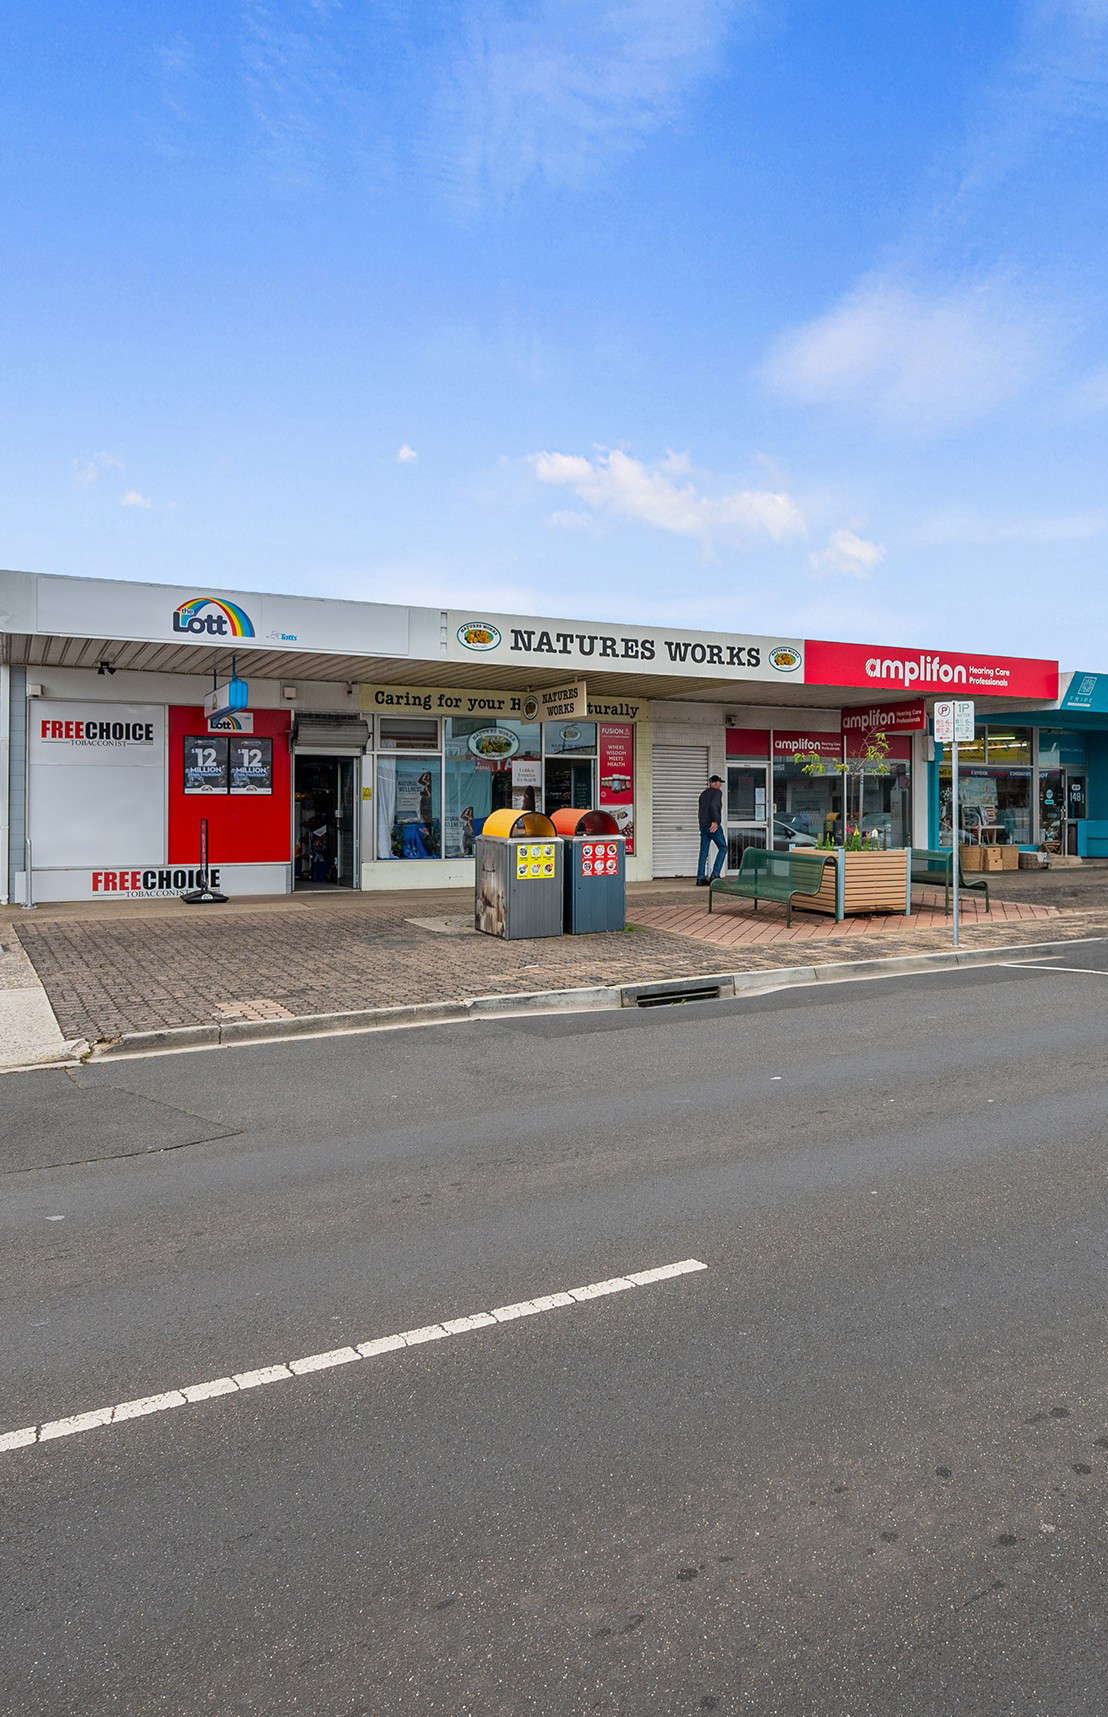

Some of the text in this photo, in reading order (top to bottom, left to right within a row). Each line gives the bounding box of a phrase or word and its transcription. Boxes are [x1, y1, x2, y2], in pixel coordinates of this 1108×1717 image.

[173, 611, 228, 636] Lott
[280, 633, 298, 641] Tatts
[510, 629, 761, 667] NATURES WORKS
[865, 655, 1011, 687] amplifon Hearing Care
[969, 677, 1009, 687] Professionals
[374, 690, 433, 710] Caring
[437, 693, 463, 708] for
[467, 698, 505, 712] your
[541, 687, 579, 705] NATURES
[1069, 695, 1094, 703] TRIBE
[546, 702, 575, 717] WORKS
[586, 703, 640, 719] turally
[210, 719, 232, 730] Lott
[842, 709, 896, 732] amplifon
[41, 720, 154, 741] FREECHOICE
[472, 729, 516, 742] NATURES WORKS
[601, 727, 624, 735] FUSION
[774, 738, 821, 752] amplifon
[1069, 792, 1081, 802] 148
[125, 889, 191, 898] TOBACCONIST
